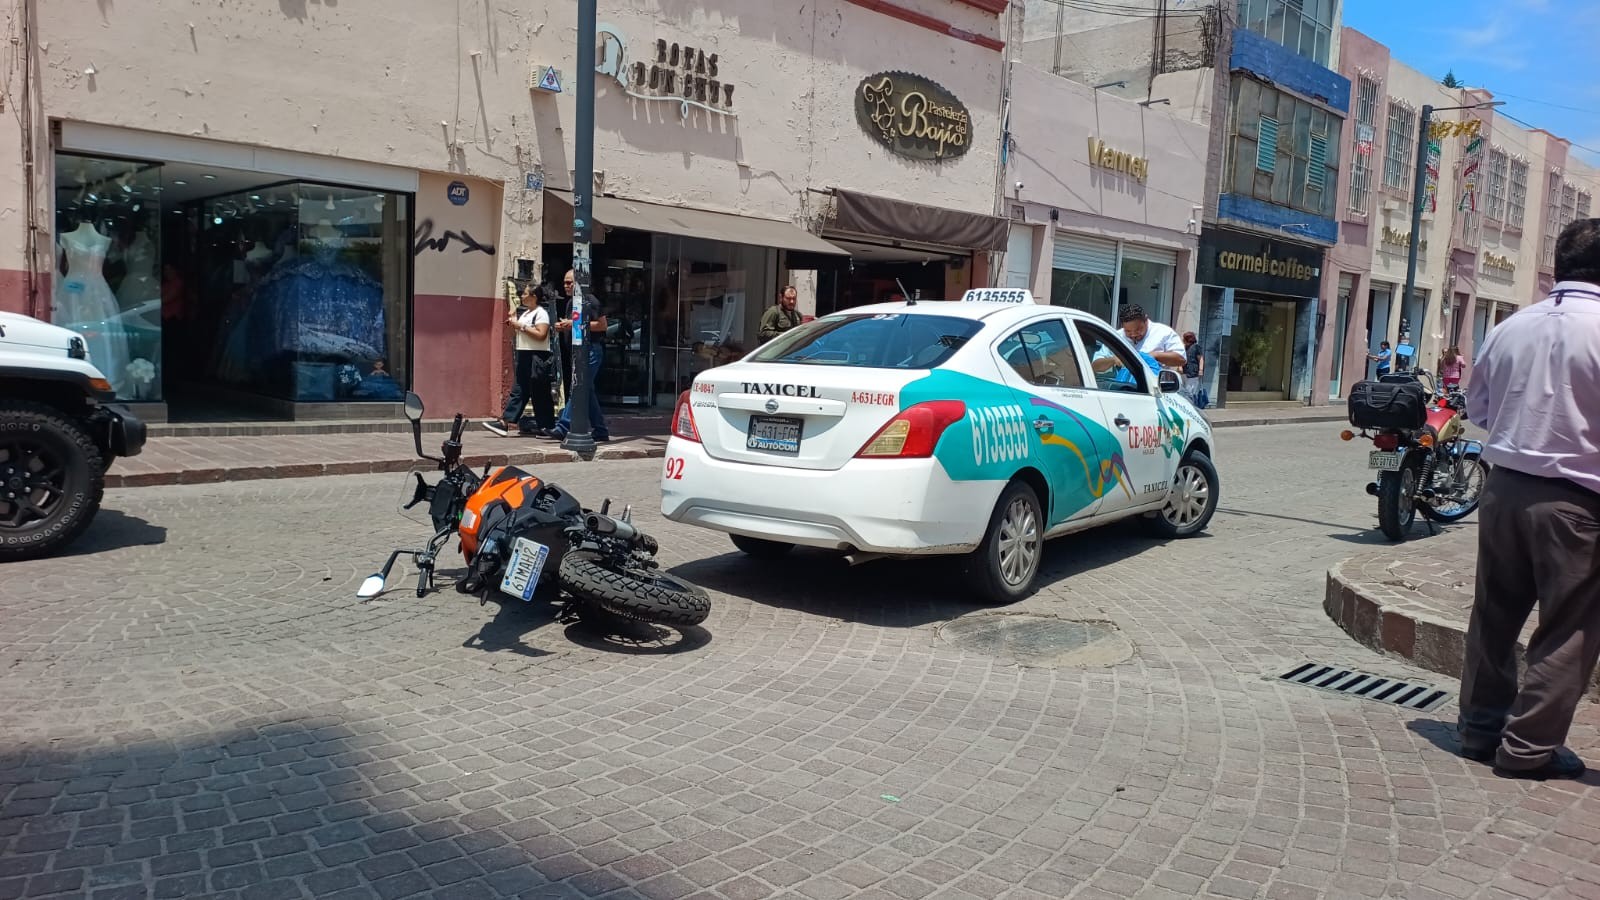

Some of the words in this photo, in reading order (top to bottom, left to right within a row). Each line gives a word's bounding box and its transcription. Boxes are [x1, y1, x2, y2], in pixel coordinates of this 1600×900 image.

[657, 38, 718, 77] BOTAS
[1088, 136, 1149, 182] Vianney
[451, 187, 466, 197] ADT
[1219, 249, 1268, 273] carmel
[1269, 257, 1312, 281] coffee
[966, 290, 1025, 304] 6135555
[741, 382, 821, 398] TAXICEL
[851, 391, 894, 406] A-631-EGR
[968, 404, 1029, 466] 6135555
[757, 442, 798, 452] AUTOCOM
[665, 457, 684, 480] 92
